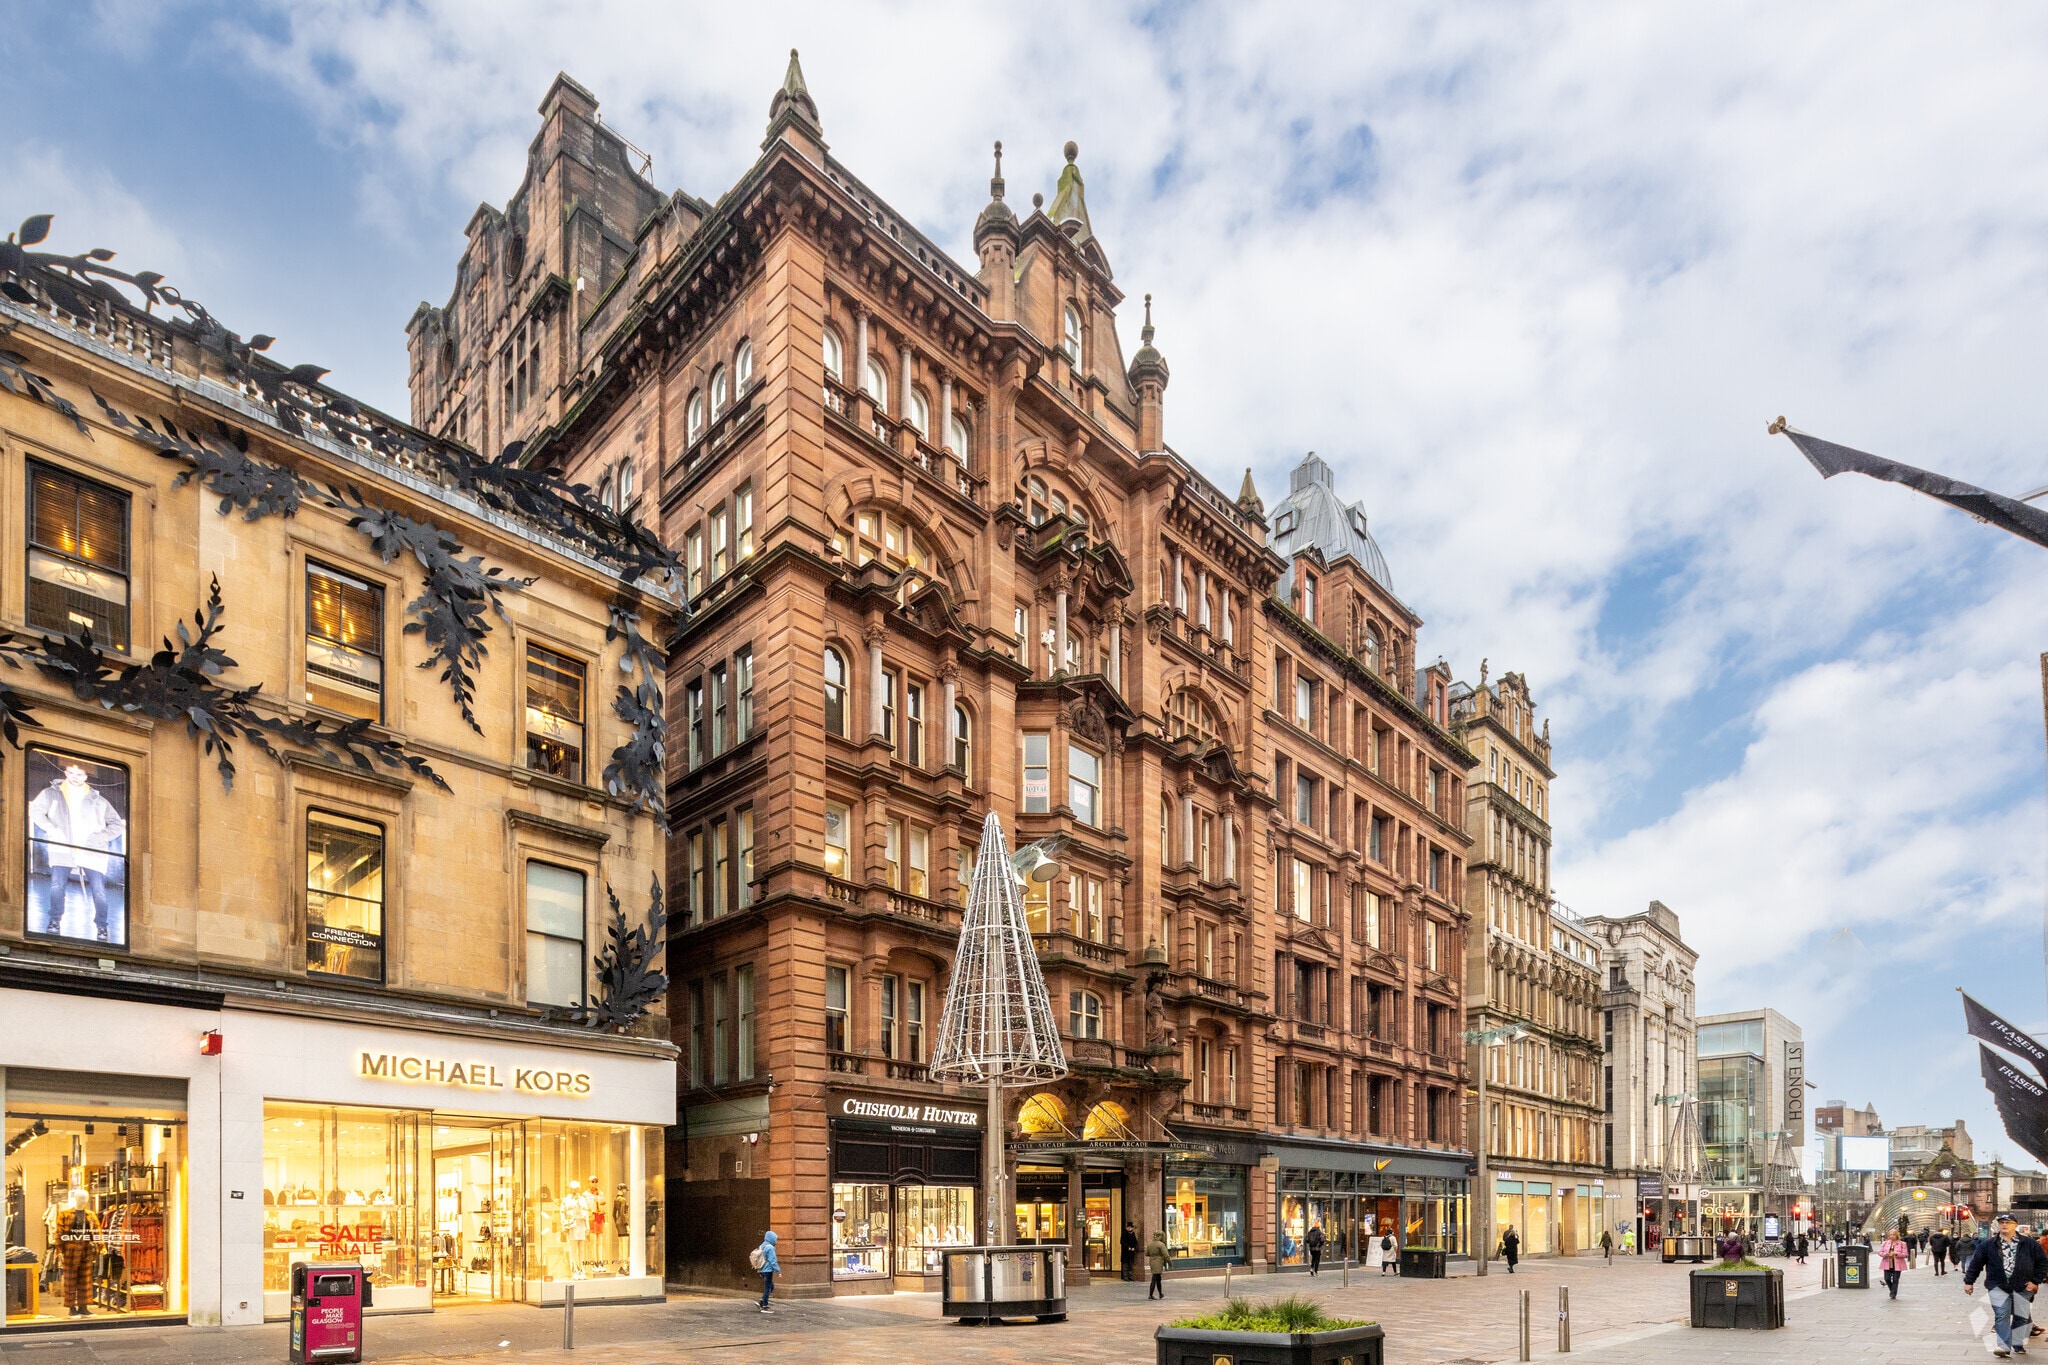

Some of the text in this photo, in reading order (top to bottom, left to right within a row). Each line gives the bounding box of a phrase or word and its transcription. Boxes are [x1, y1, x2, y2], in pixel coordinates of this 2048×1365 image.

[312, 931, 377, 948] CONNECTION
[325, 927, 364, 940] FRENCH
[1990, 1019, 2046, 1060] FRASERS
[361, 1052, 591, 1094] MICHAEL KORS
[1998, 1064, 2044, 1097] FRASERS
[1788, 1047, 1802, 1121] ST ENOCH
[842, 1098, 978, 1126] CHISHOLM HUNTER
[1219, 1143, 1236, 1154] Webb
[1498, 1171, 1512, 1180] ZARA
[60, 1234, 141, 1242] GIVE BETTER
[320, 1224, 383, 1243] SALE
[319, 1242, 383, 1257] FINALE
[320, 1307, 344, 1315] PEOPLE
[311, 1317, 343, 1325] GLASGOW
